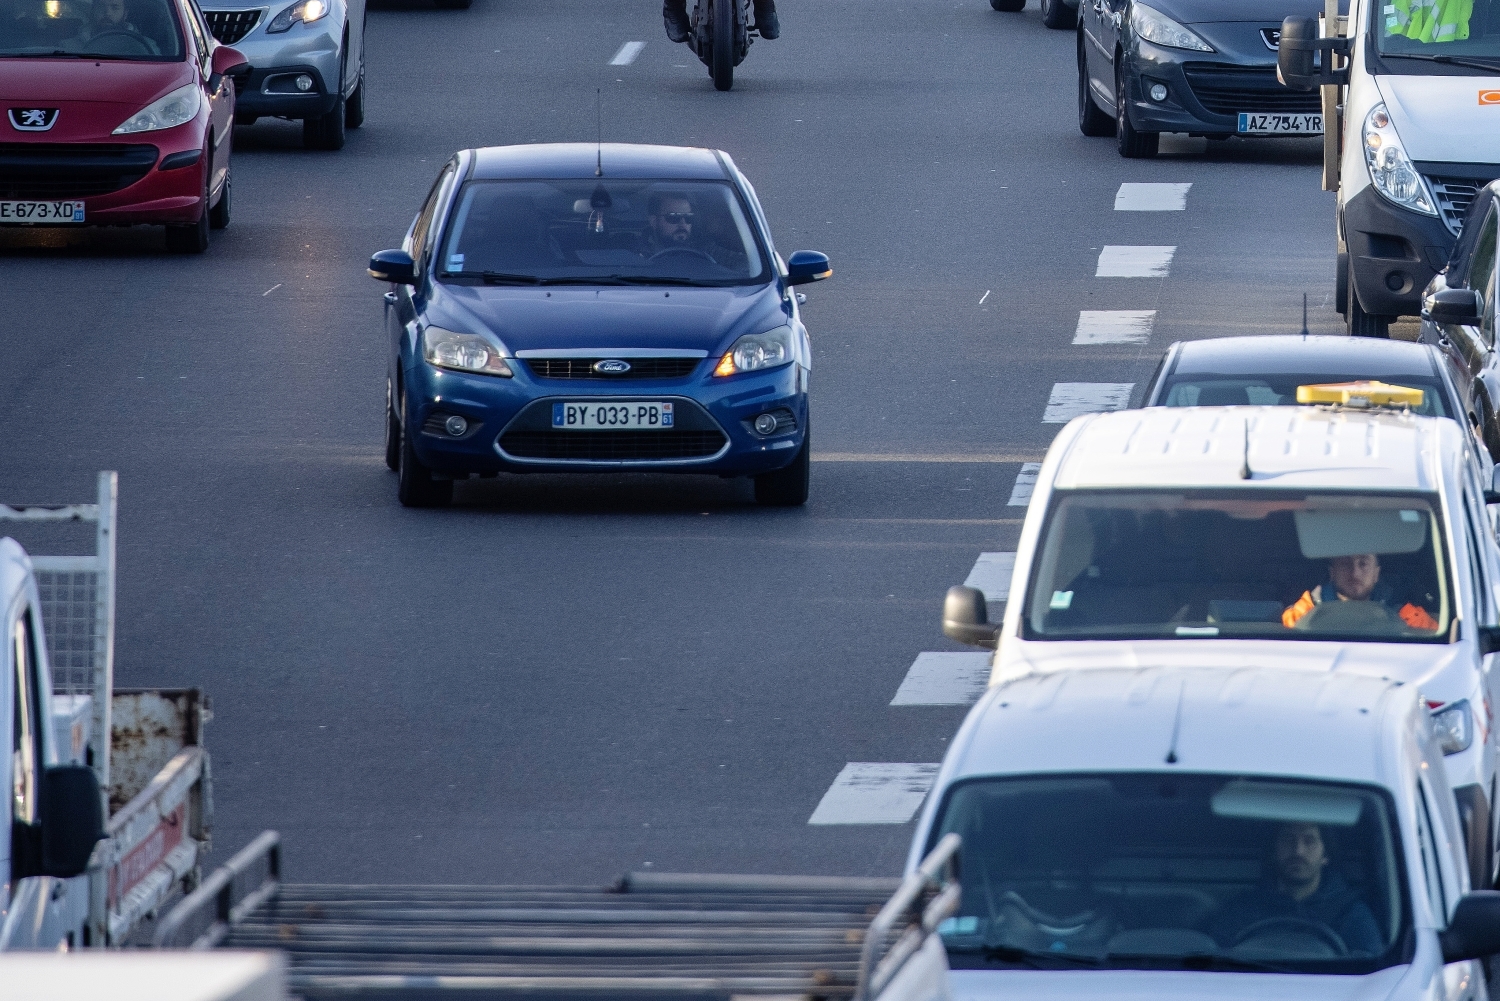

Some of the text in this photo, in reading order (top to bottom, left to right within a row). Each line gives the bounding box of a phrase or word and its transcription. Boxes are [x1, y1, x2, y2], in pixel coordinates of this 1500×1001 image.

[1248, 115, 1322, 131] AZ-754-YR
[567, 406, 672, 425] BY-033-PB 61
